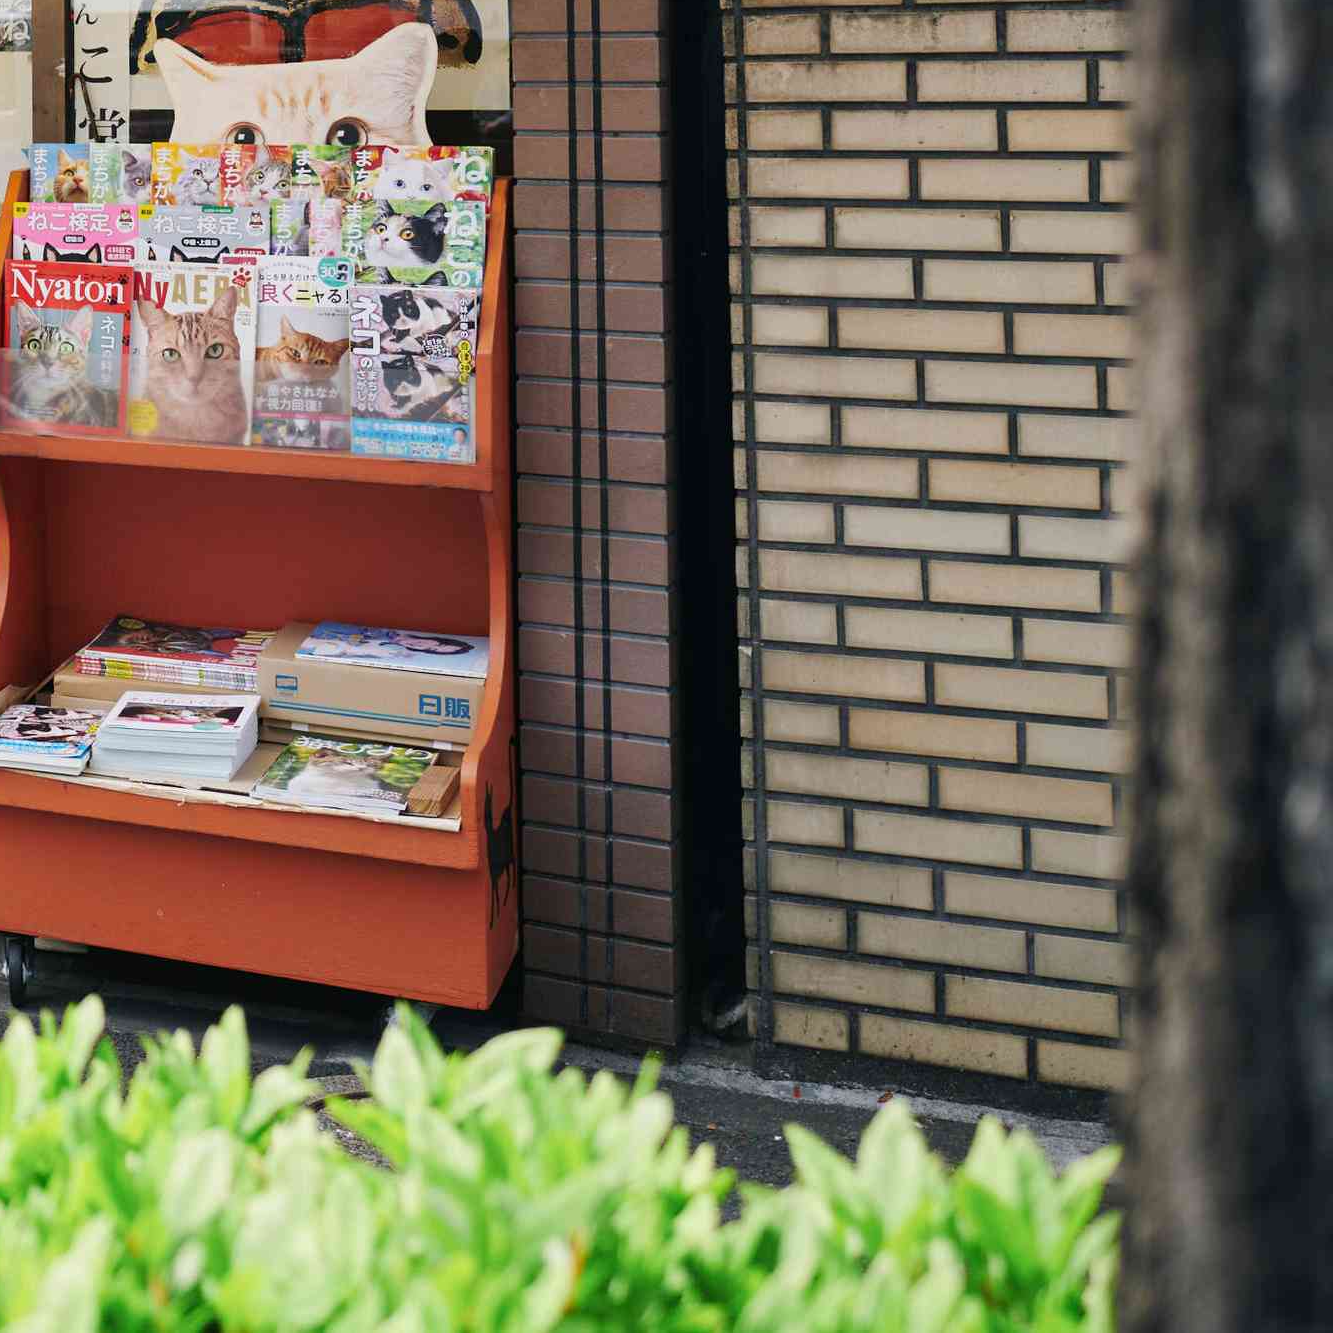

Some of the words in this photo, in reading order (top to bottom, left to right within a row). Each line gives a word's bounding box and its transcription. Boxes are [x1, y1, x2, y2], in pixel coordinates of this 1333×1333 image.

[28, 213, 113, 237] ねこ検定
[154, 215, 242, 240] ねこ検定
[10, 268, 126, 307] Nyaton
[418, 693, 471, 719] 日販
